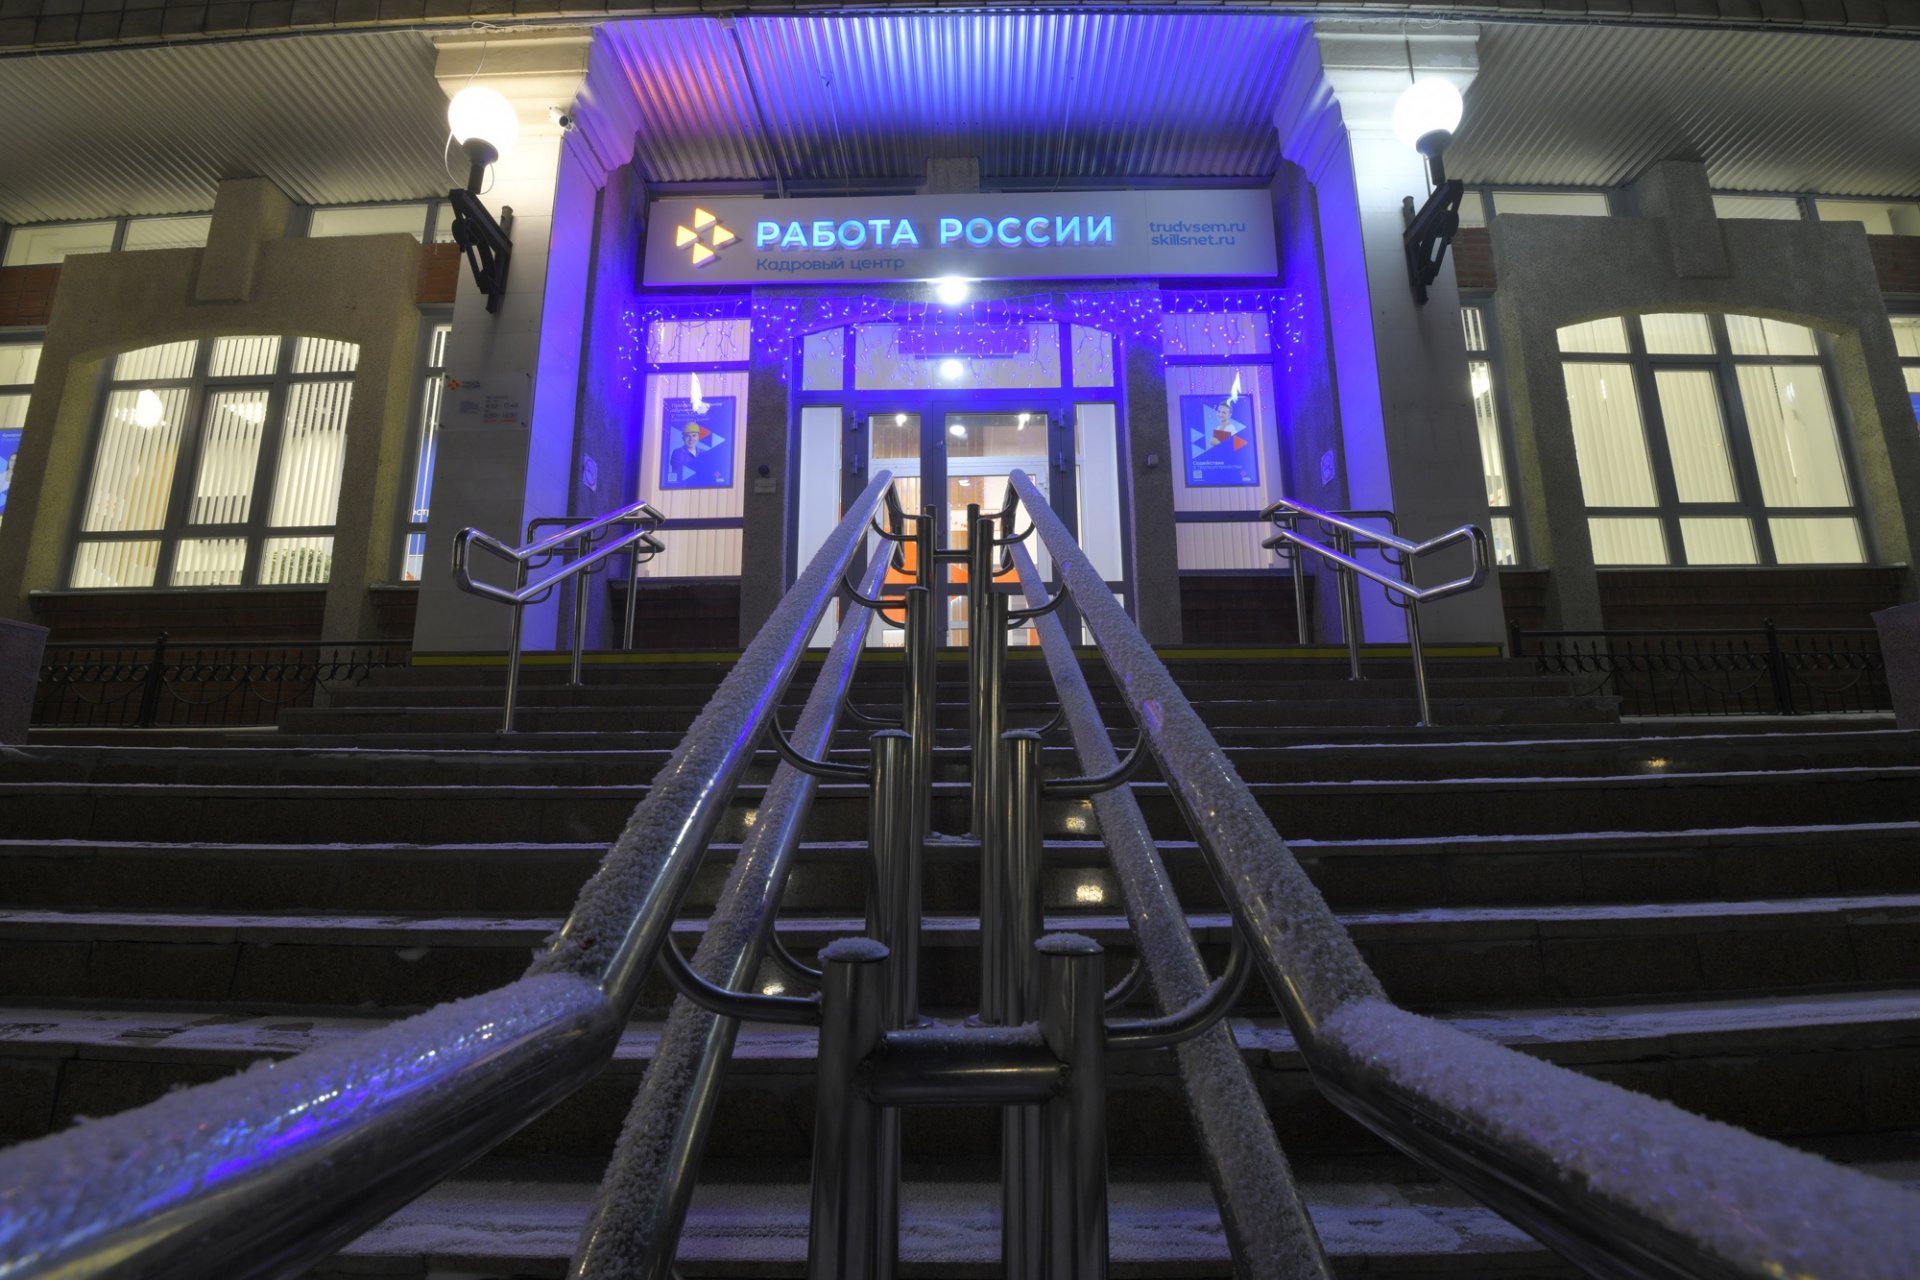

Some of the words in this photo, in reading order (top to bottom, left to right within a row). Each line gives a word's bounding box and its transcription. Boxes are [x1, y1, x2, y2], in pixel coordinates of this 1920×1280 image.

[756, 218, 919, 248] РАБОТА
[940, 215, 1113, 246] РОССИИ
[1149, 221, 1246, 234] trudvsem.ru
[1151, 233, 1236, 246] skillsnet.ru
[756, 257, 844, 273] Кадровый
[850, 258, 905, 272] центр
